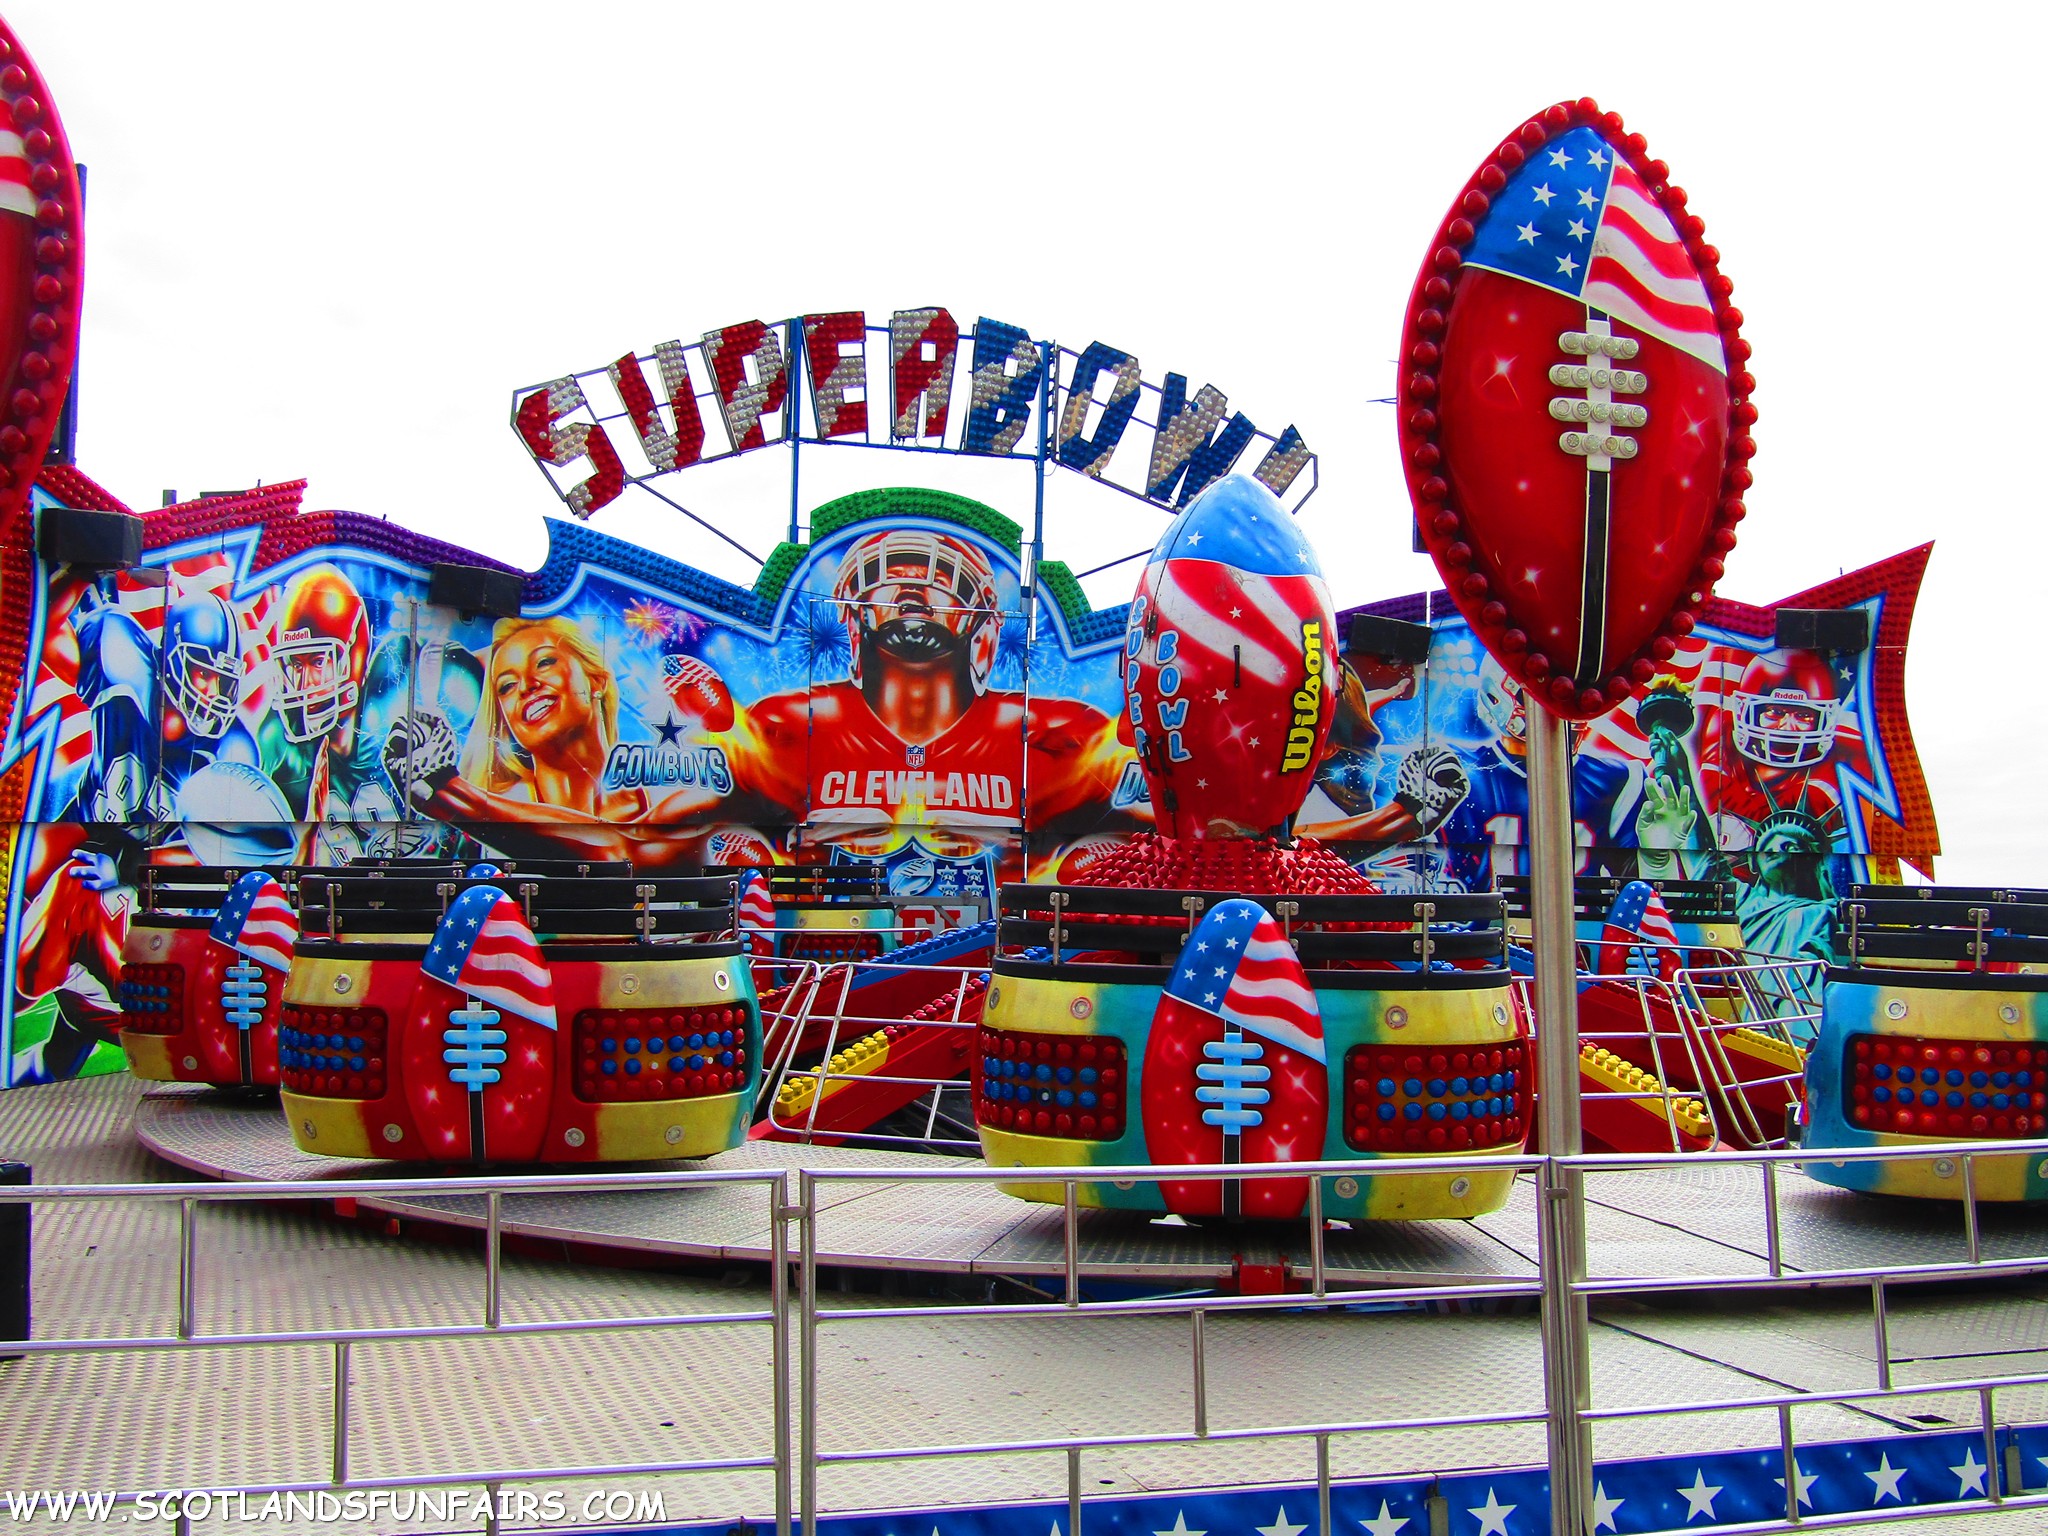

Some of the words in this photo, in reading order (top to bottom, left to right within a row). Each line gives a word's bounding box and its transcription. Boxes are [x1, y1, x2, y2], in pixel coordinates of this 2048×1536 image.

[284, 631, 309, 642] Riddell
[1156, 630, 1192, 763] BOWL
[1282, 621, 1321, 773] Wilson
[1774, 692, 1804, 701] Riddell
[604, 744, 732, 794] COWBOYS
[908, 754, 923, 766] NFL
[820, 770, 1014, 809] CLEVELAND
